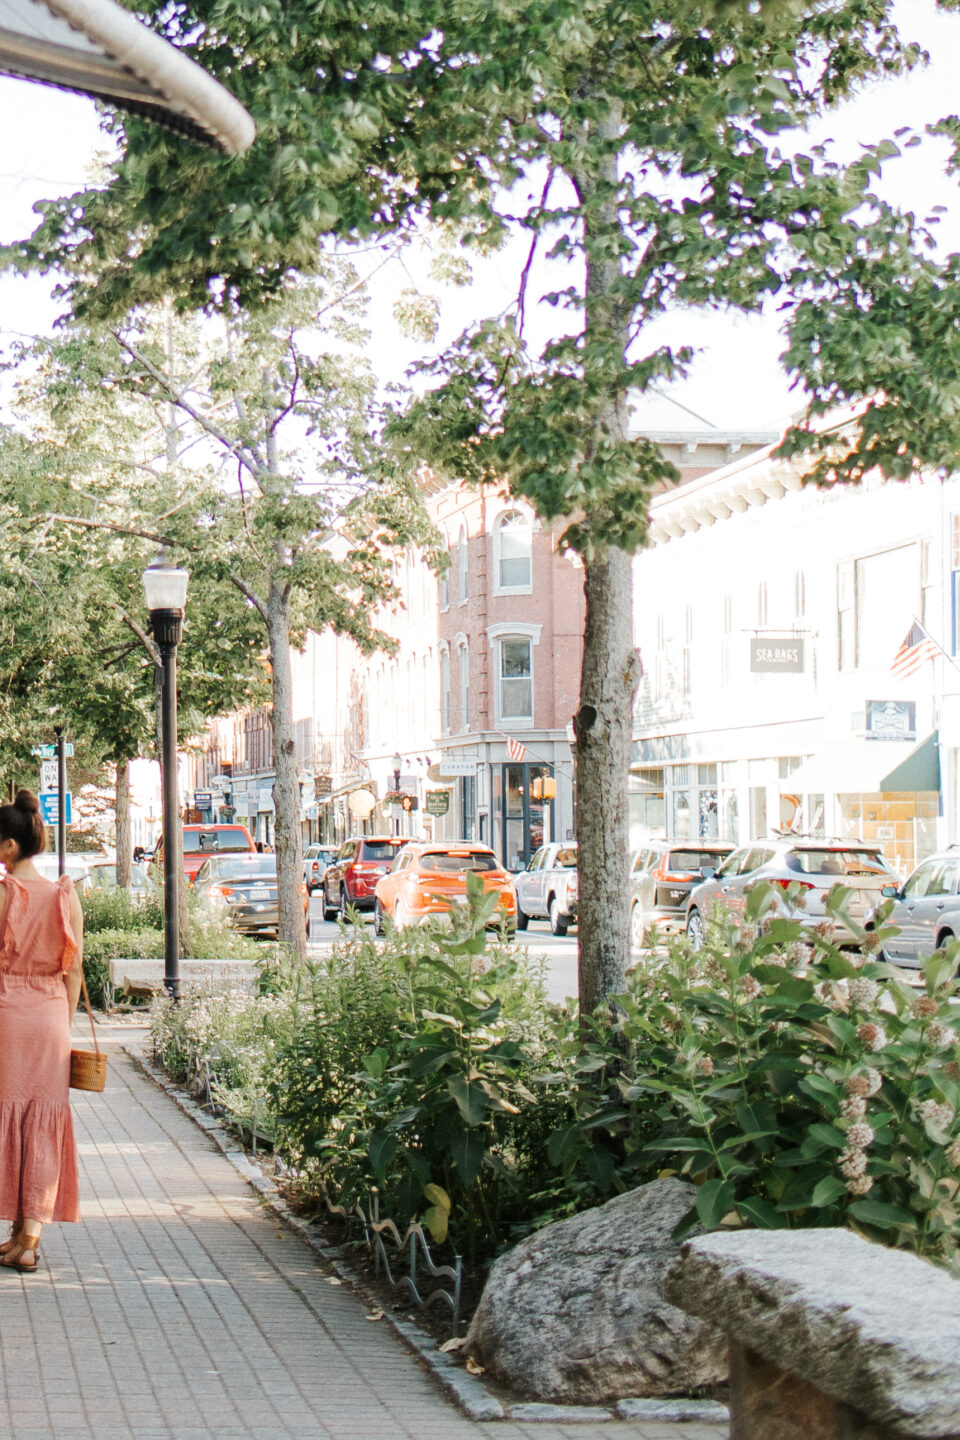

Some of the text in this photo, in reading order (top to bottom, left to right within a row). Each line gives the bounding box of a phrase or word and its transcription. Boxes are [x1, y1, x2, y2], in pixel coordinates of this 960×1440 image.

[756, 648, 799, 664] SEA BAGS
[44, 765, 58, 773] ON
[44, 774, 58, 782] WA
